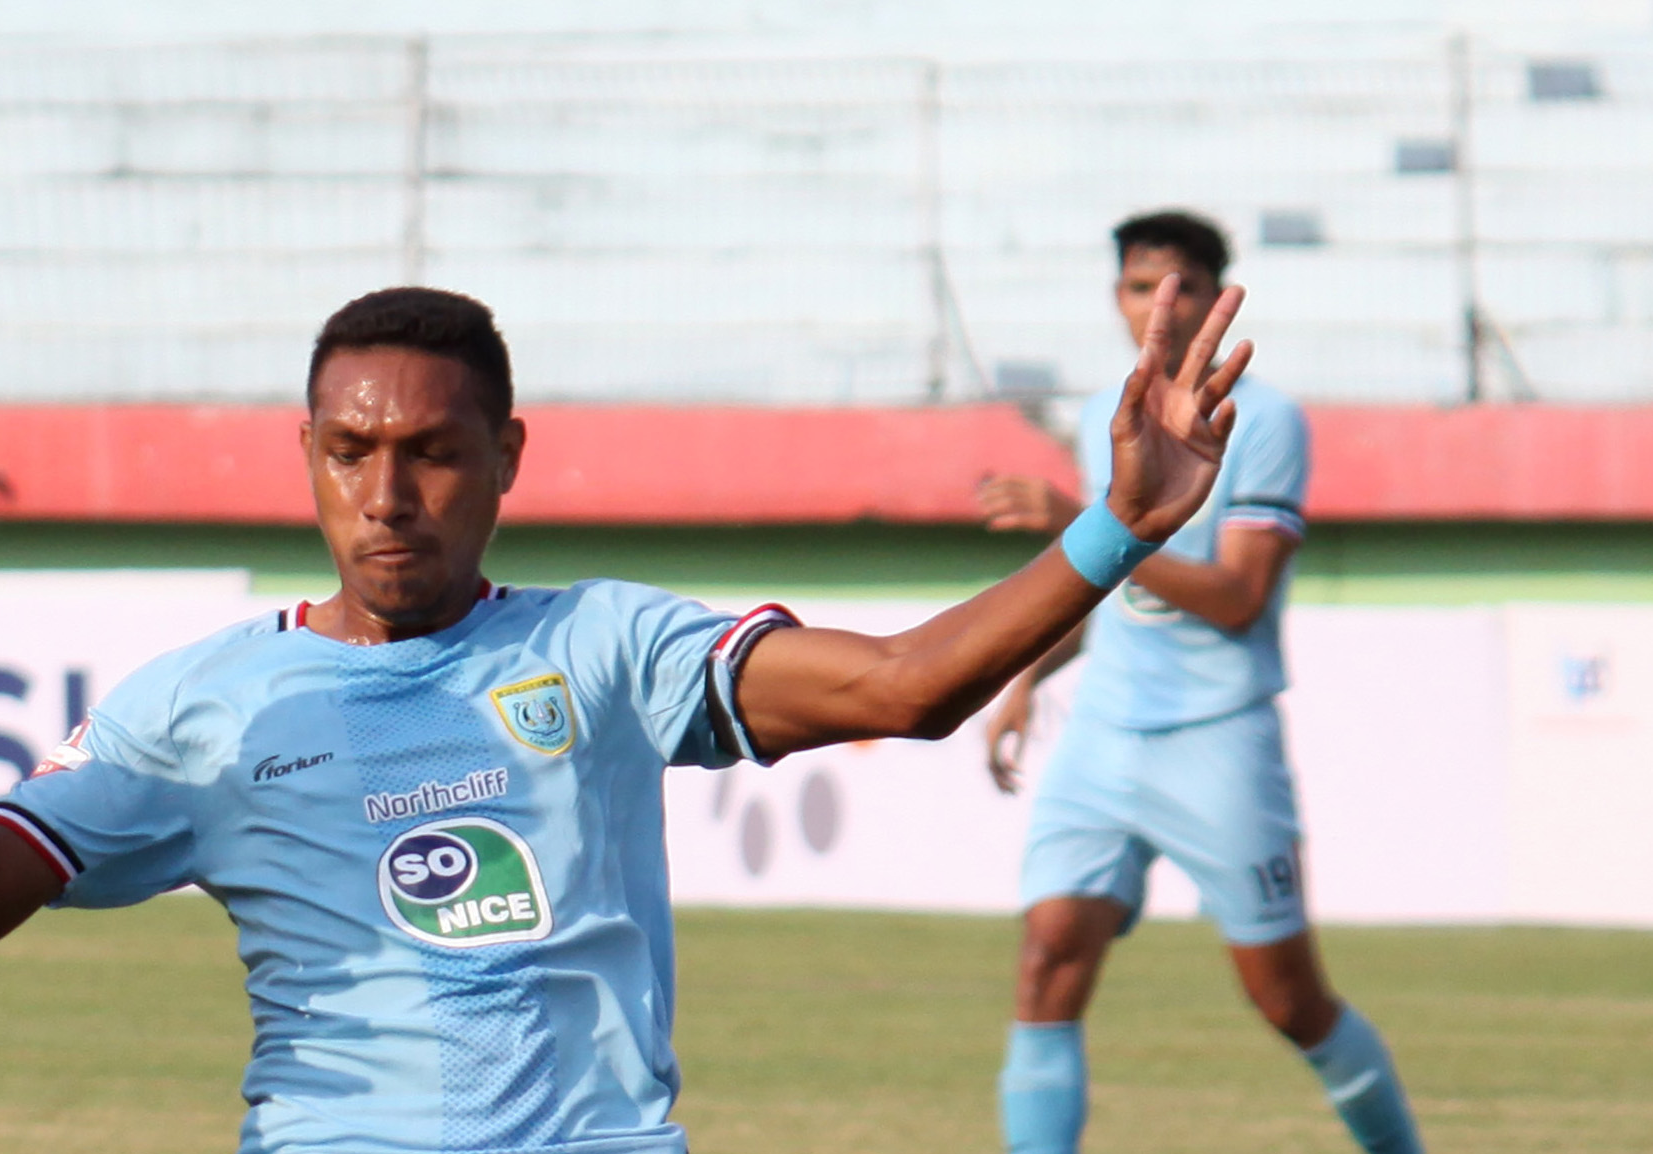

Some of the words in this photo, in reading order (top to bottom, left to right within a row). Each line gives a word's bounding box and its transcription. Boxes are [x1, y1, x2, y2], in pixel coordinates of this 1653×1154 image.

[364, 767, 509, 823] Northcliff
[393, 845, 467, 885] SO
[1248, 856, 1295, 902] 19
[437, 892, 536, 934] NICE
